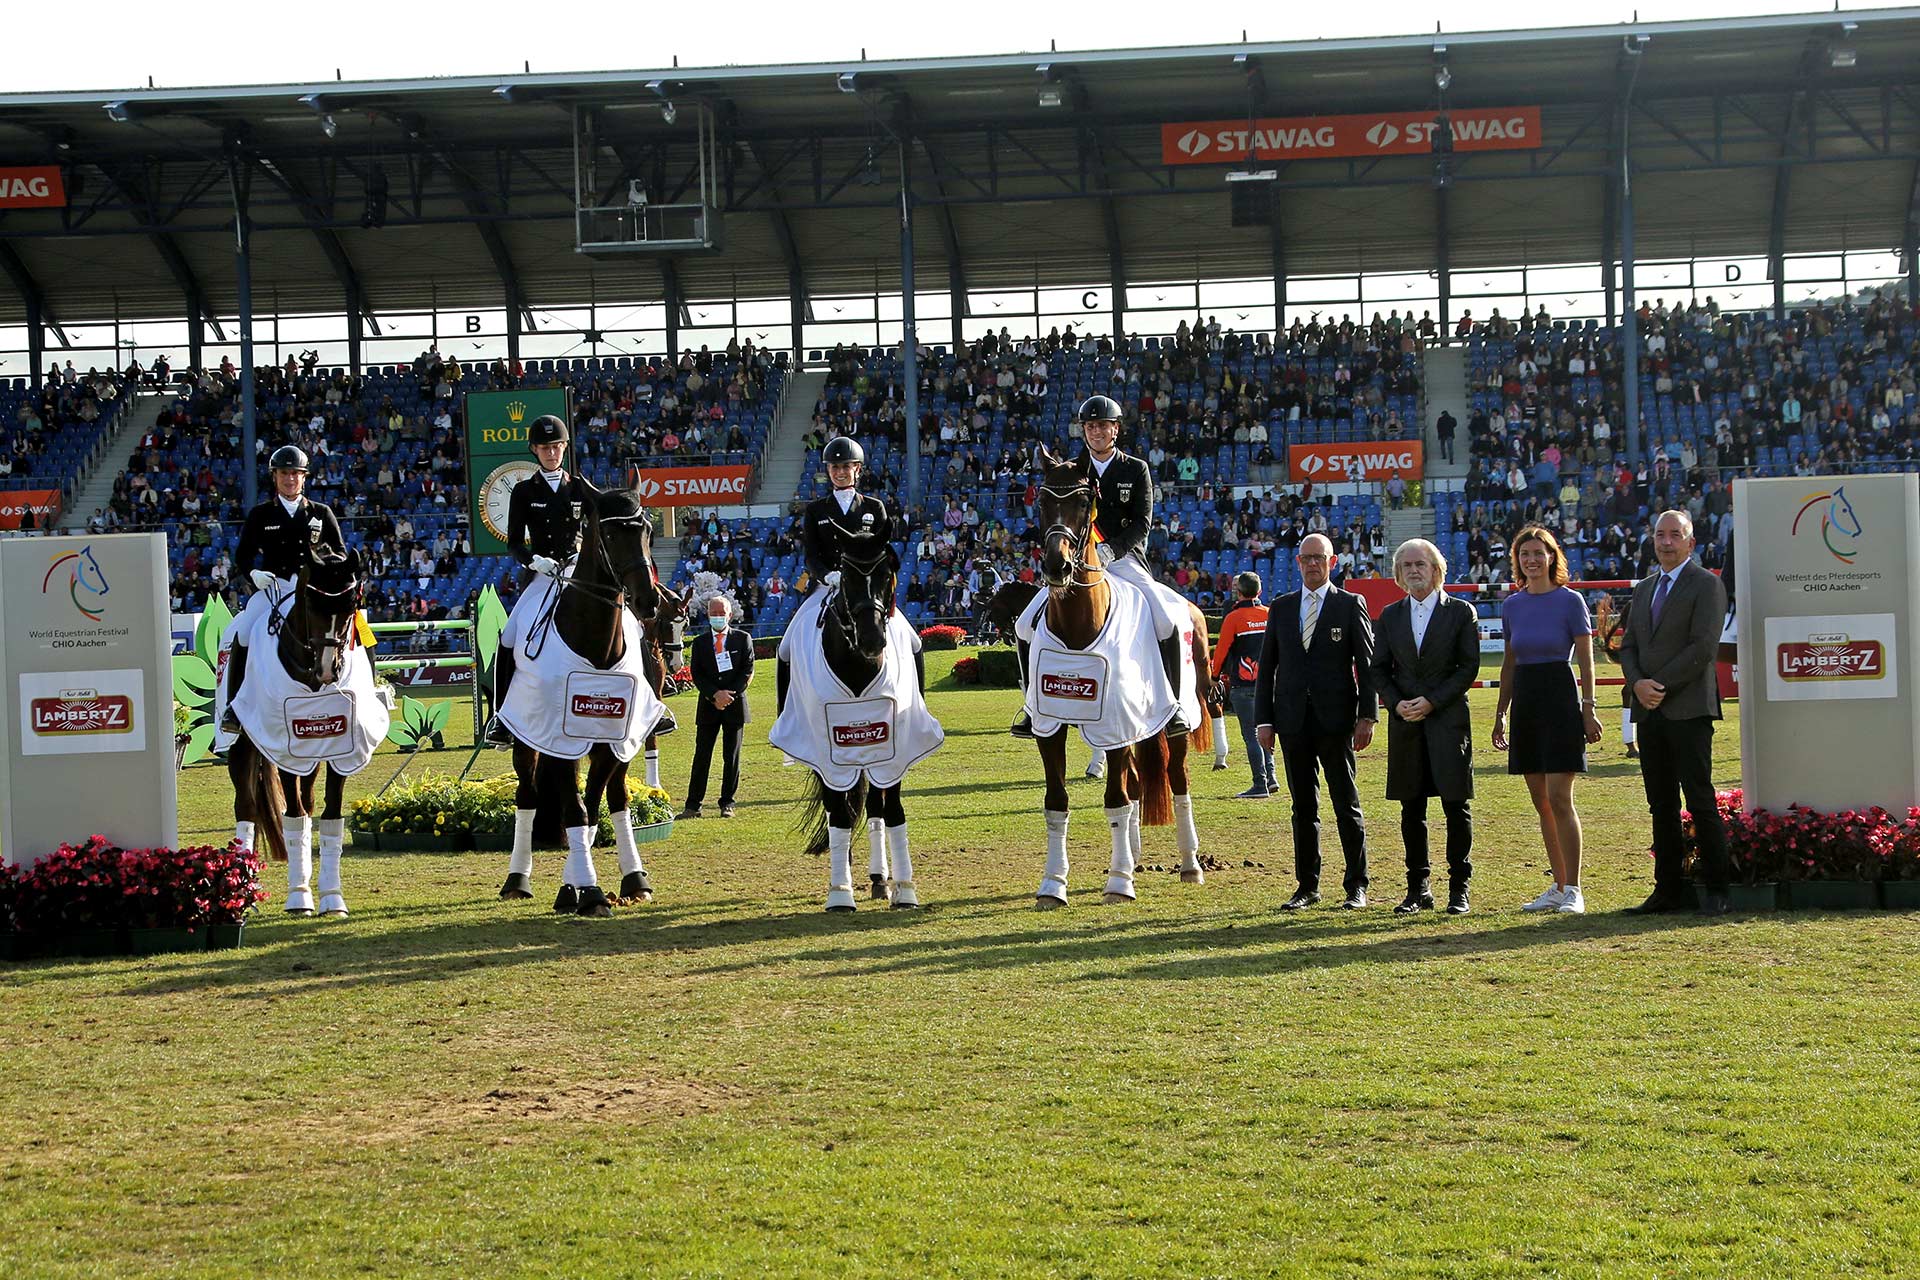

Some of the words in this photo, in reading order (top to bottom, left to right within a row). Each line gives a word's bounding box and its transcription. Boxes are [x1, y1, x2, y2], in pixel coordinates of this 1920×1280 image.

[1217, 127, 1335, 152] STAWAG
[1405, 118, 1526, 144] STWAG
[1726, 264, 1741, 282] D
[1082, 291, 1098, 309] C
[466, 315, 481, 333] B
[664, 477, 745, 496] STAWAG
[1775, 573, 1811, 582] Weltfest
[1812, 572, 1828, 581] des
[1828, 571, 1882, 581] Pferdesports
[1803, 584, 1828, 592] CHIO
[1828, 583, 1861, 591] Aachen
[29, 629, 53, 639] World
[54, 628, 97, 639] Equestrian
[97, 627, 129, 637] Festival
[52, 640, 75, 648] CHIO
[75, 639, 107, 648] Aachen
[1783, 649, 1878, 673] LAMBERTZ
[448, 671, 472, 682] Aac
[1043, 679, 1093, 696] LAMBERTZ
[574, 699, 622, 715] LAMBERTZ
[35, 704, 125, 728] LAMBERTZ
[294, 720, 344, 735] LAMBERTZ
[835, 726, 885, 742] LAMBERTZ
